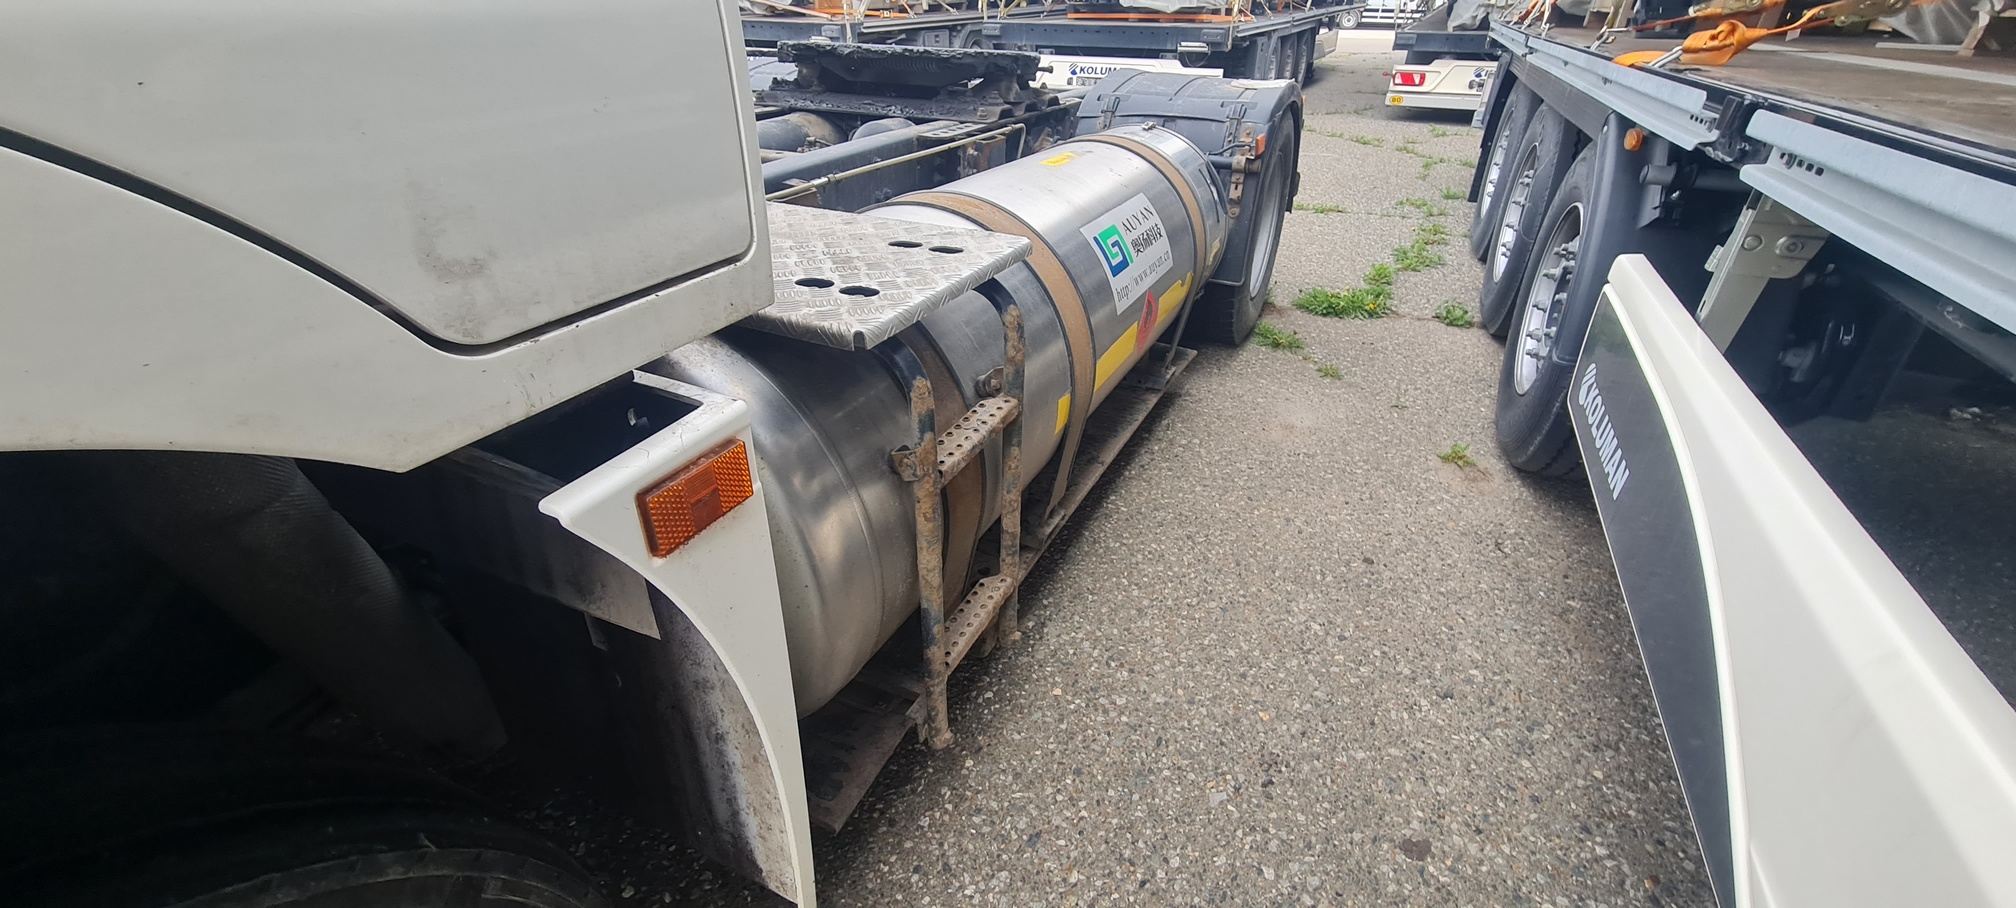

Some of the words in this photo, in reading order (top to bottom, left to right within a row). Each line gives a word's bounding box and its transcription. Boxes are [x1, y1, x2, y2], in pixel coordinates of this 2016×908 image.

[1121, 205, 1155, 235] AUYAN
[1130, 222, 1164, 258] 奥扬科技
[1115, 250, 1170, 303] http://www.auyan.cn
[1583, 386, 1630, 501] KOLUMAN
